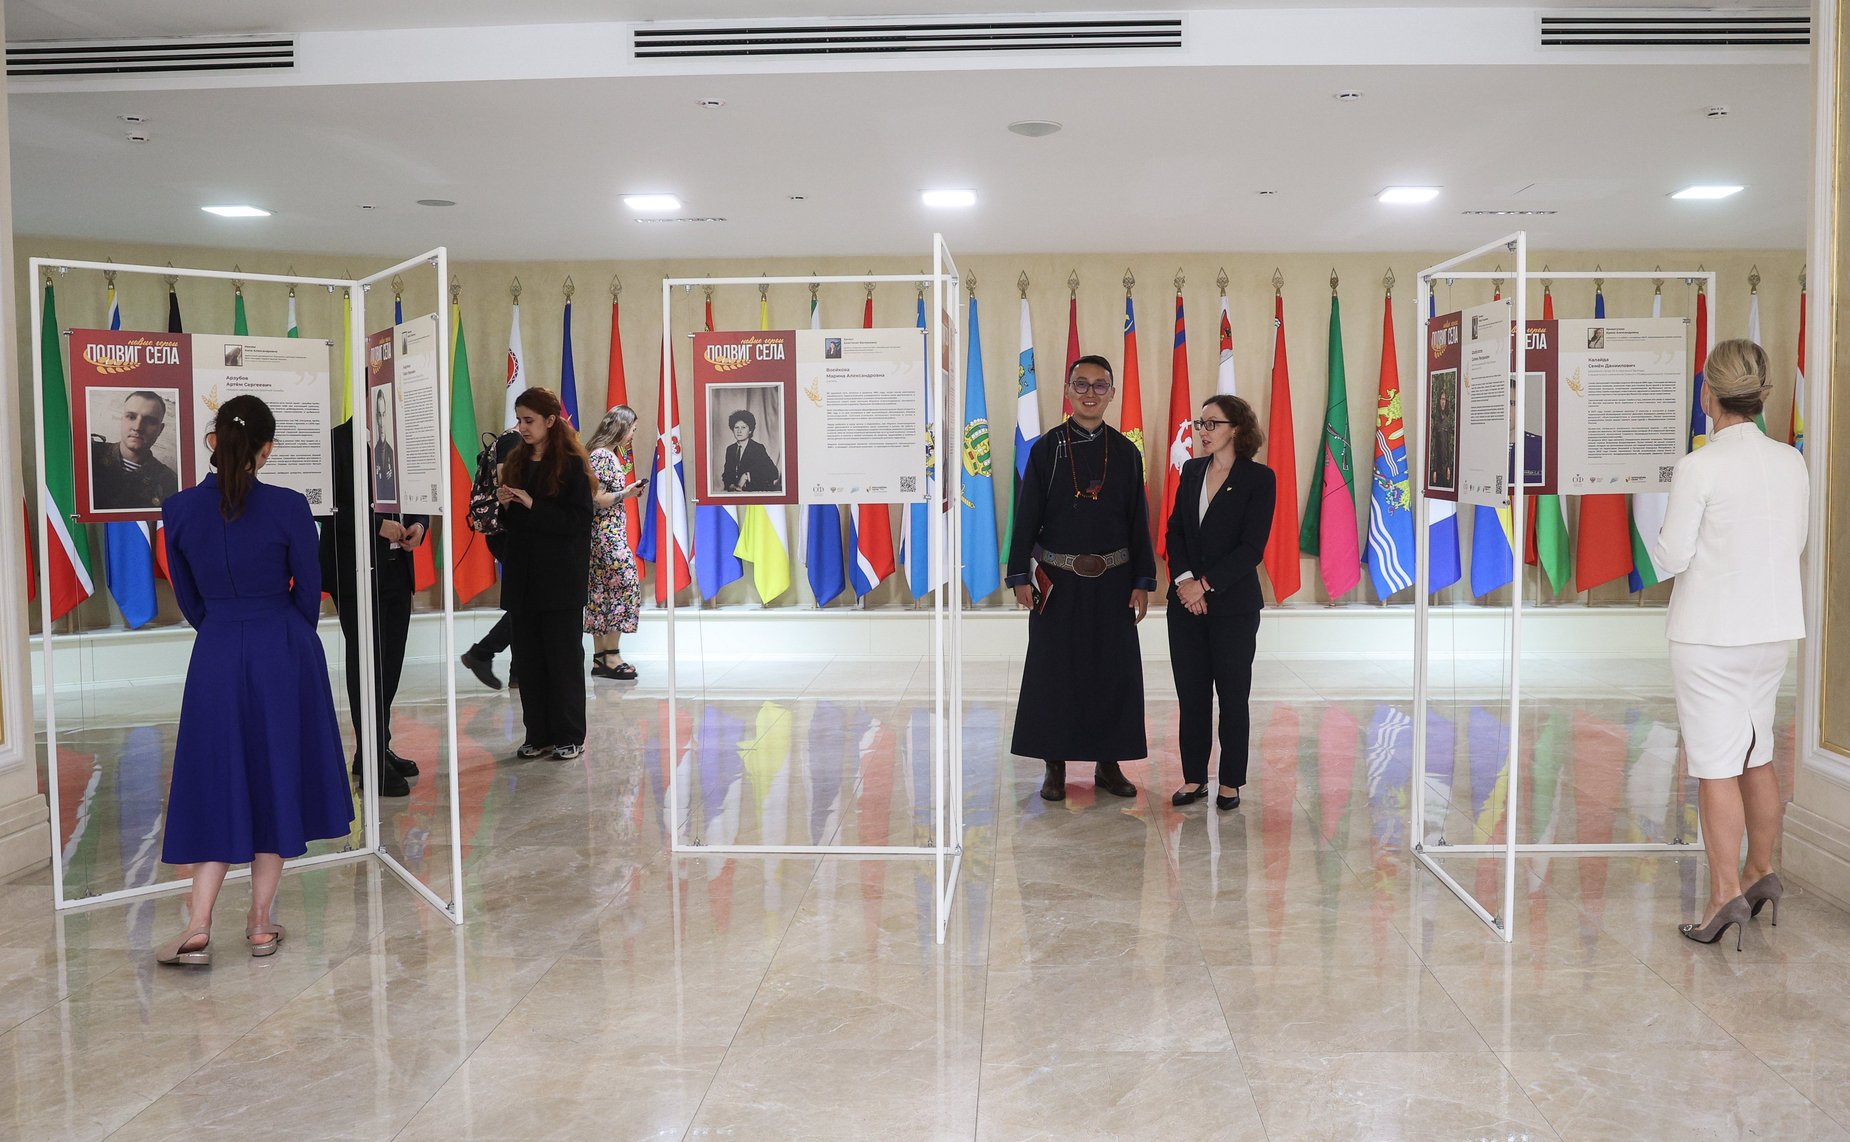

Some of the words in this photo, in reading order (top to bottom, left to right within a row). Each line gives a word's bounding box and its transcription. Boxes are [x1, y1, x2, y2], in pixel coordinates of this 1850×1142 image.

[1525, 333, 1547, 350] ЕЛА
[86, 343, 141, 364] ПОДВИГ
[146, 346, 180, 365] СЕЛА
[706, 344, 752, 362] ПОДВИГ
[756, 343, 785, 361] СЕЛА
